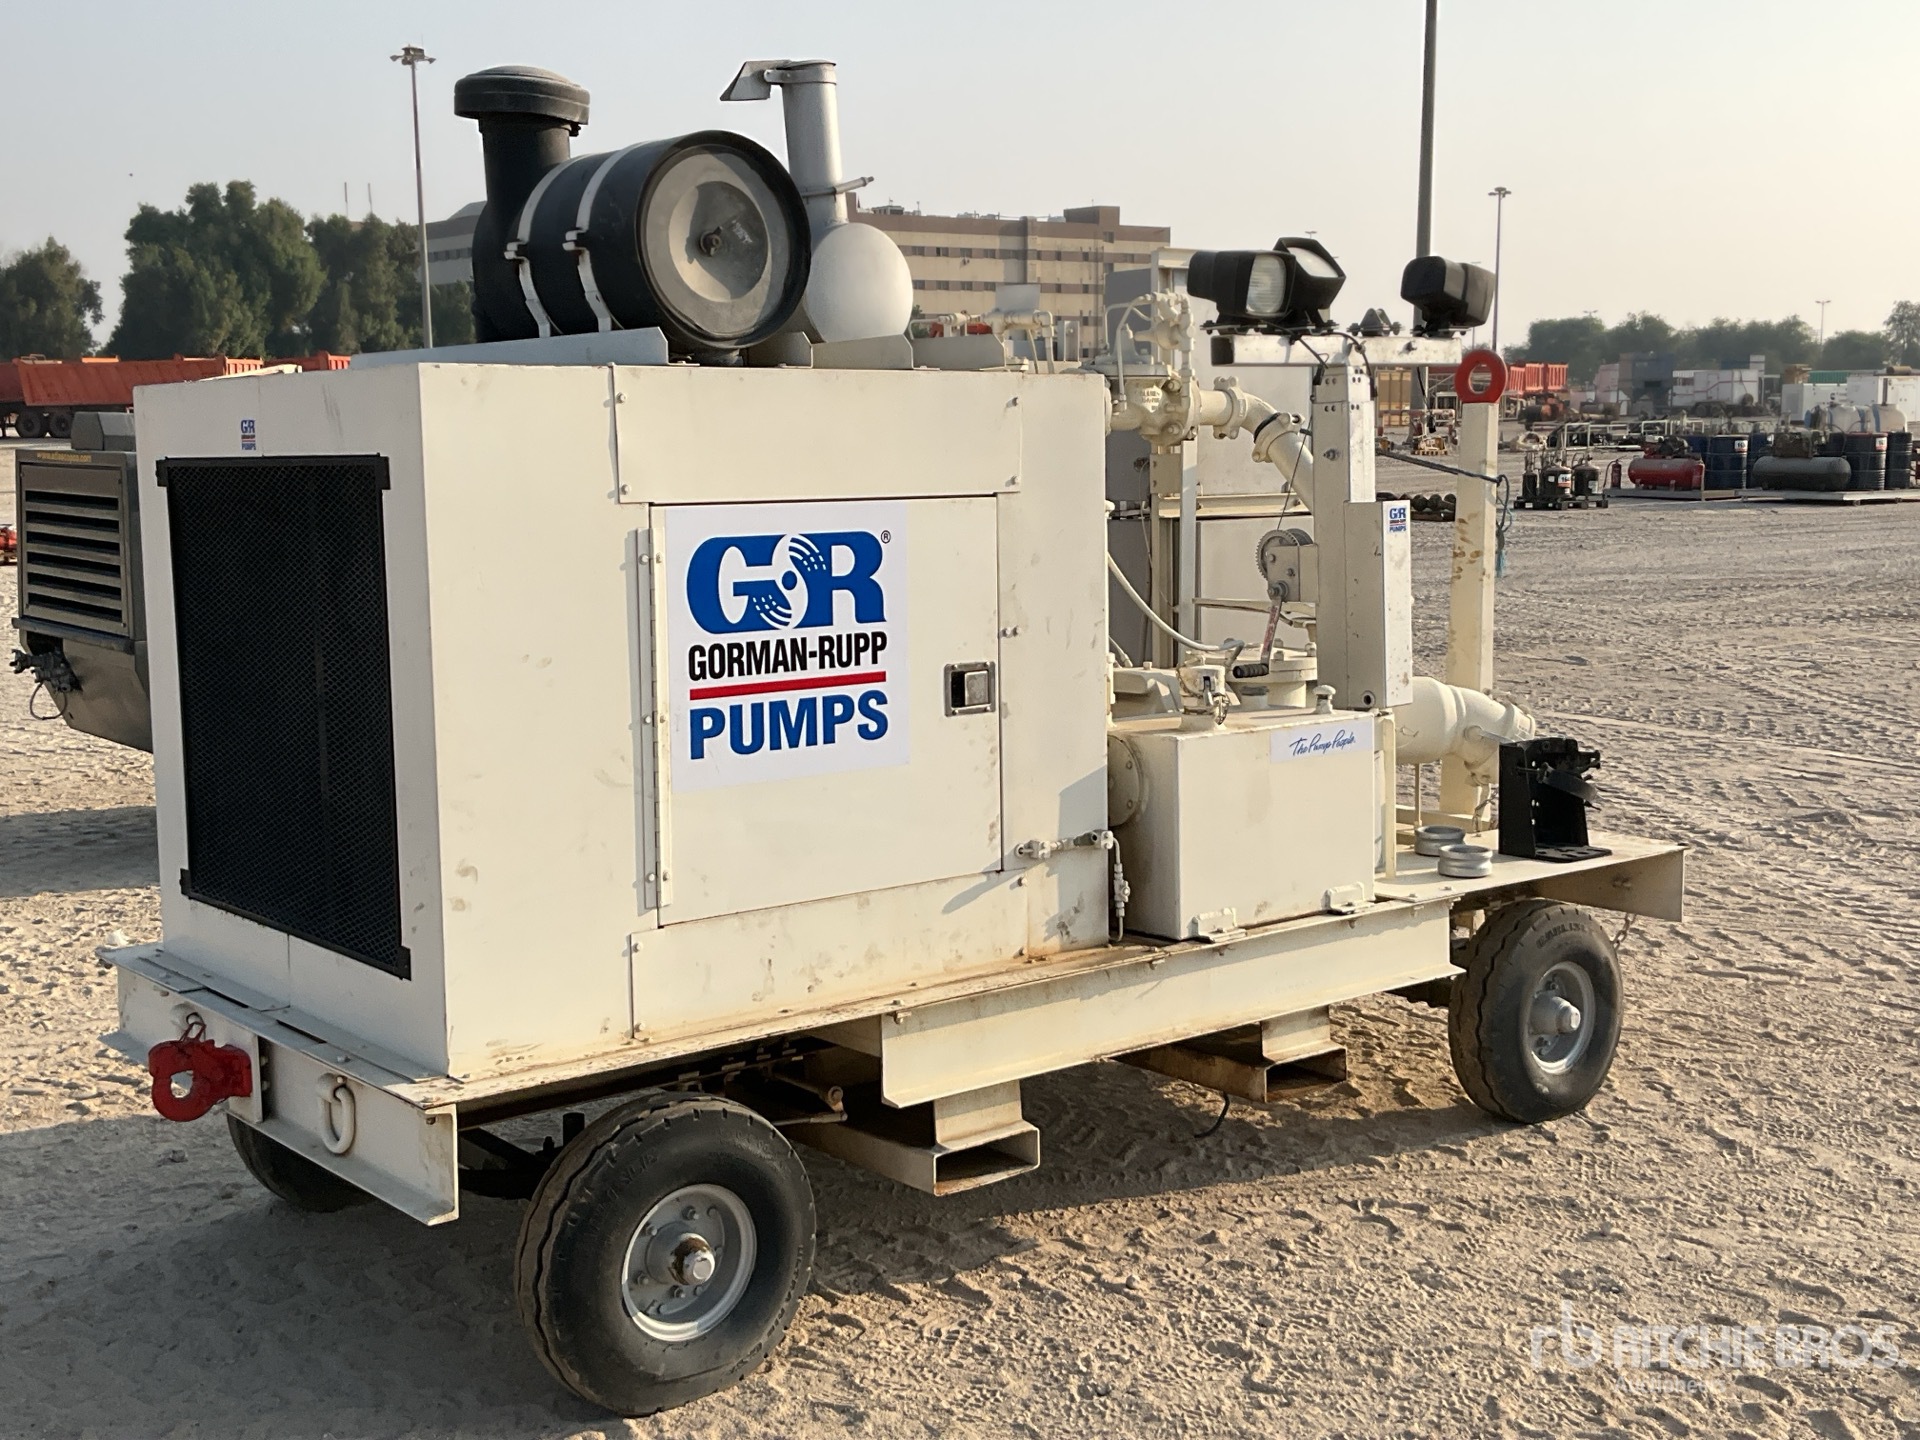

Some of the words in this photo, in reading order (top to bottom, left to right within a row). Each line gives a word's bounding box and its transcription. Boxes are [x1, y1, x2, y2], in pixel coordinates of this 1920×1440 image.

[688, 631, 888, 682] GORMAN-RUPP
[689, 689, 889, 760] PUMPS
[1289, 737, 1308, 756] The
[1307, 733, 1332, 754] Pump
